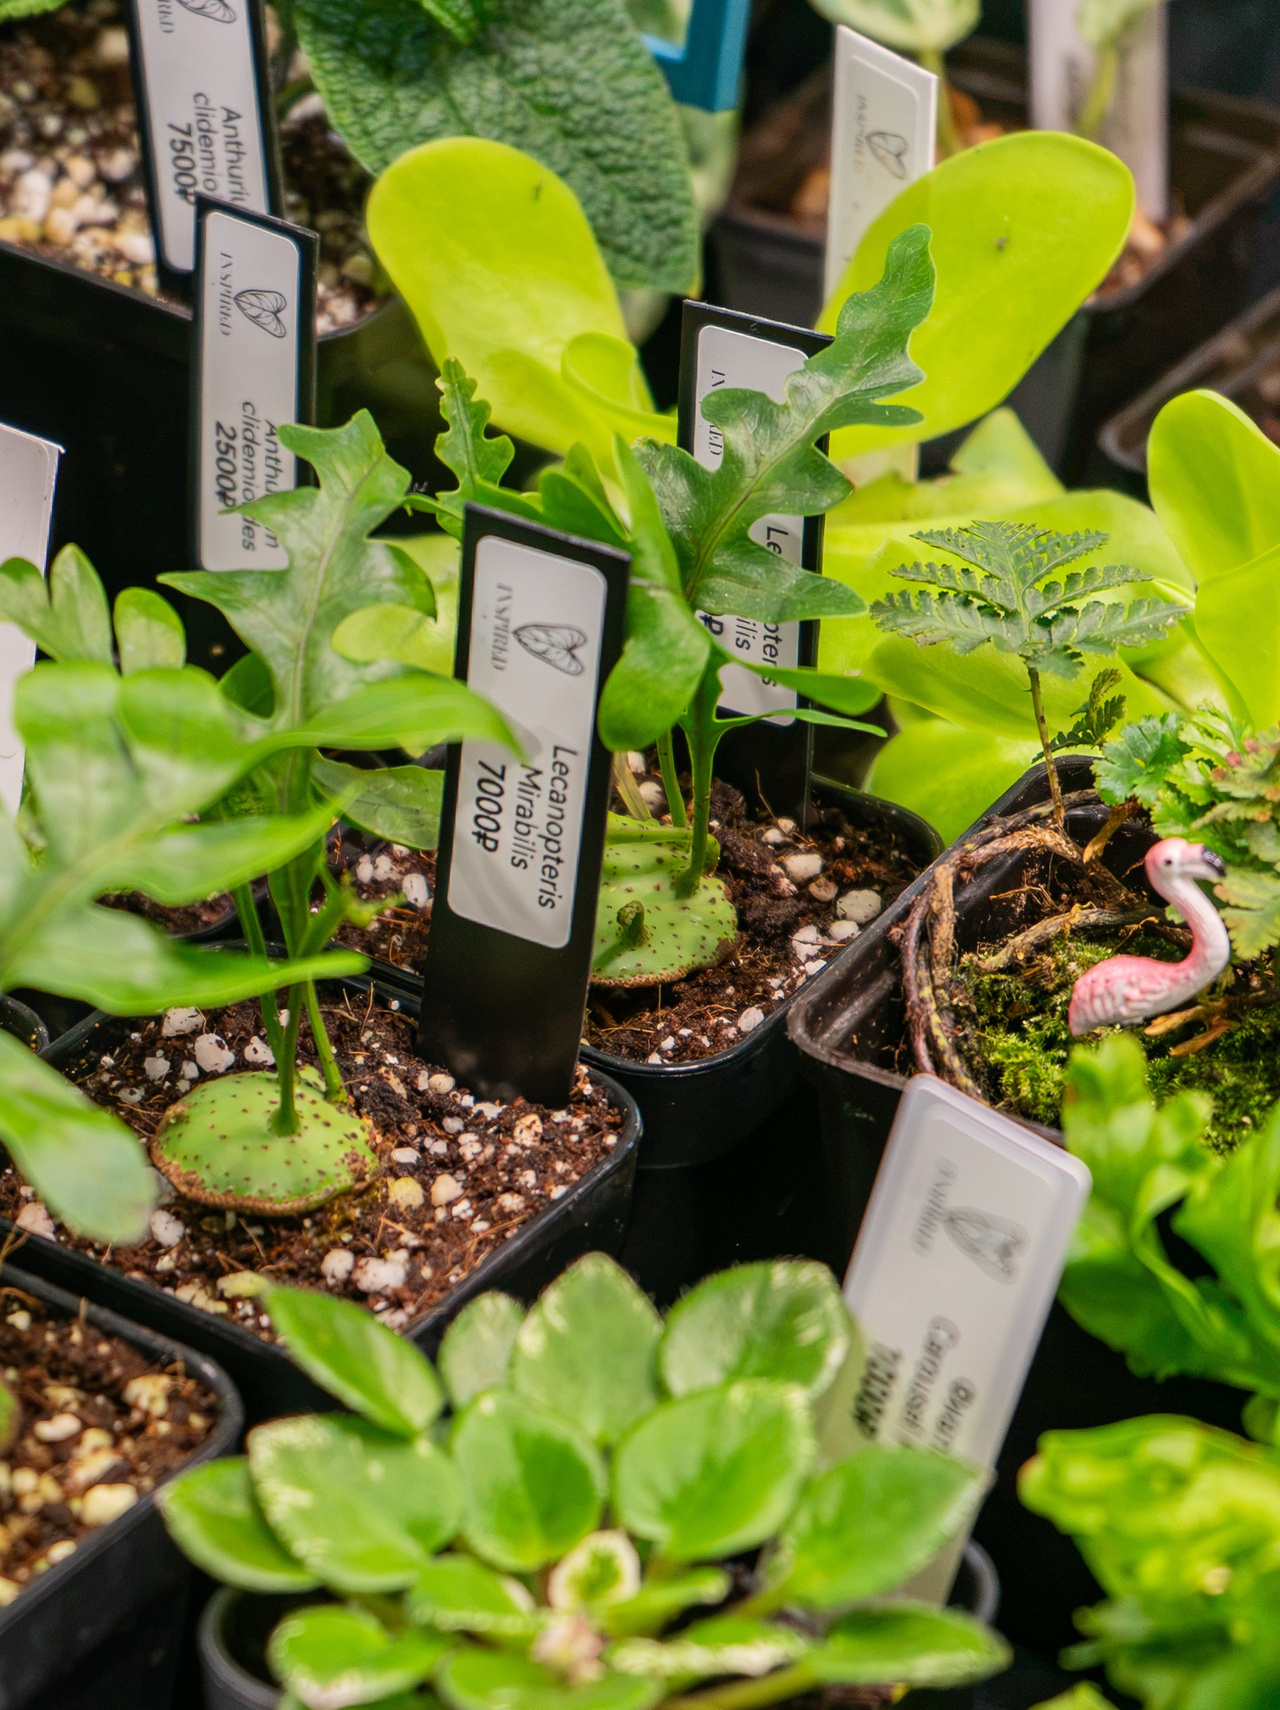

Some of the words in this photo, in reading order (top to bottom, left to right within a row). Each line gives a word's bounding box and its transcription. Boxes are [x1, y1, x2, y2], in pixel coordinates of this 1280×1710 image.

[193, 91, 218, 193] clidemio
[221, 106, 249, 202] Anthuri
[219, 251, 234, 337] INSPIRED
[215, 420, 237, 508] 2500₽
[241, 401, 262, 551] clidemiodes
[264, 419, 284, 549] Anthum
[490, 582, 514, 671] INSPIRED
[471, 759, 507, 854] 7000₽
[511, 763, 544, 872] Mirabilis
[537, 744, 579, 911] Lecanopteris
